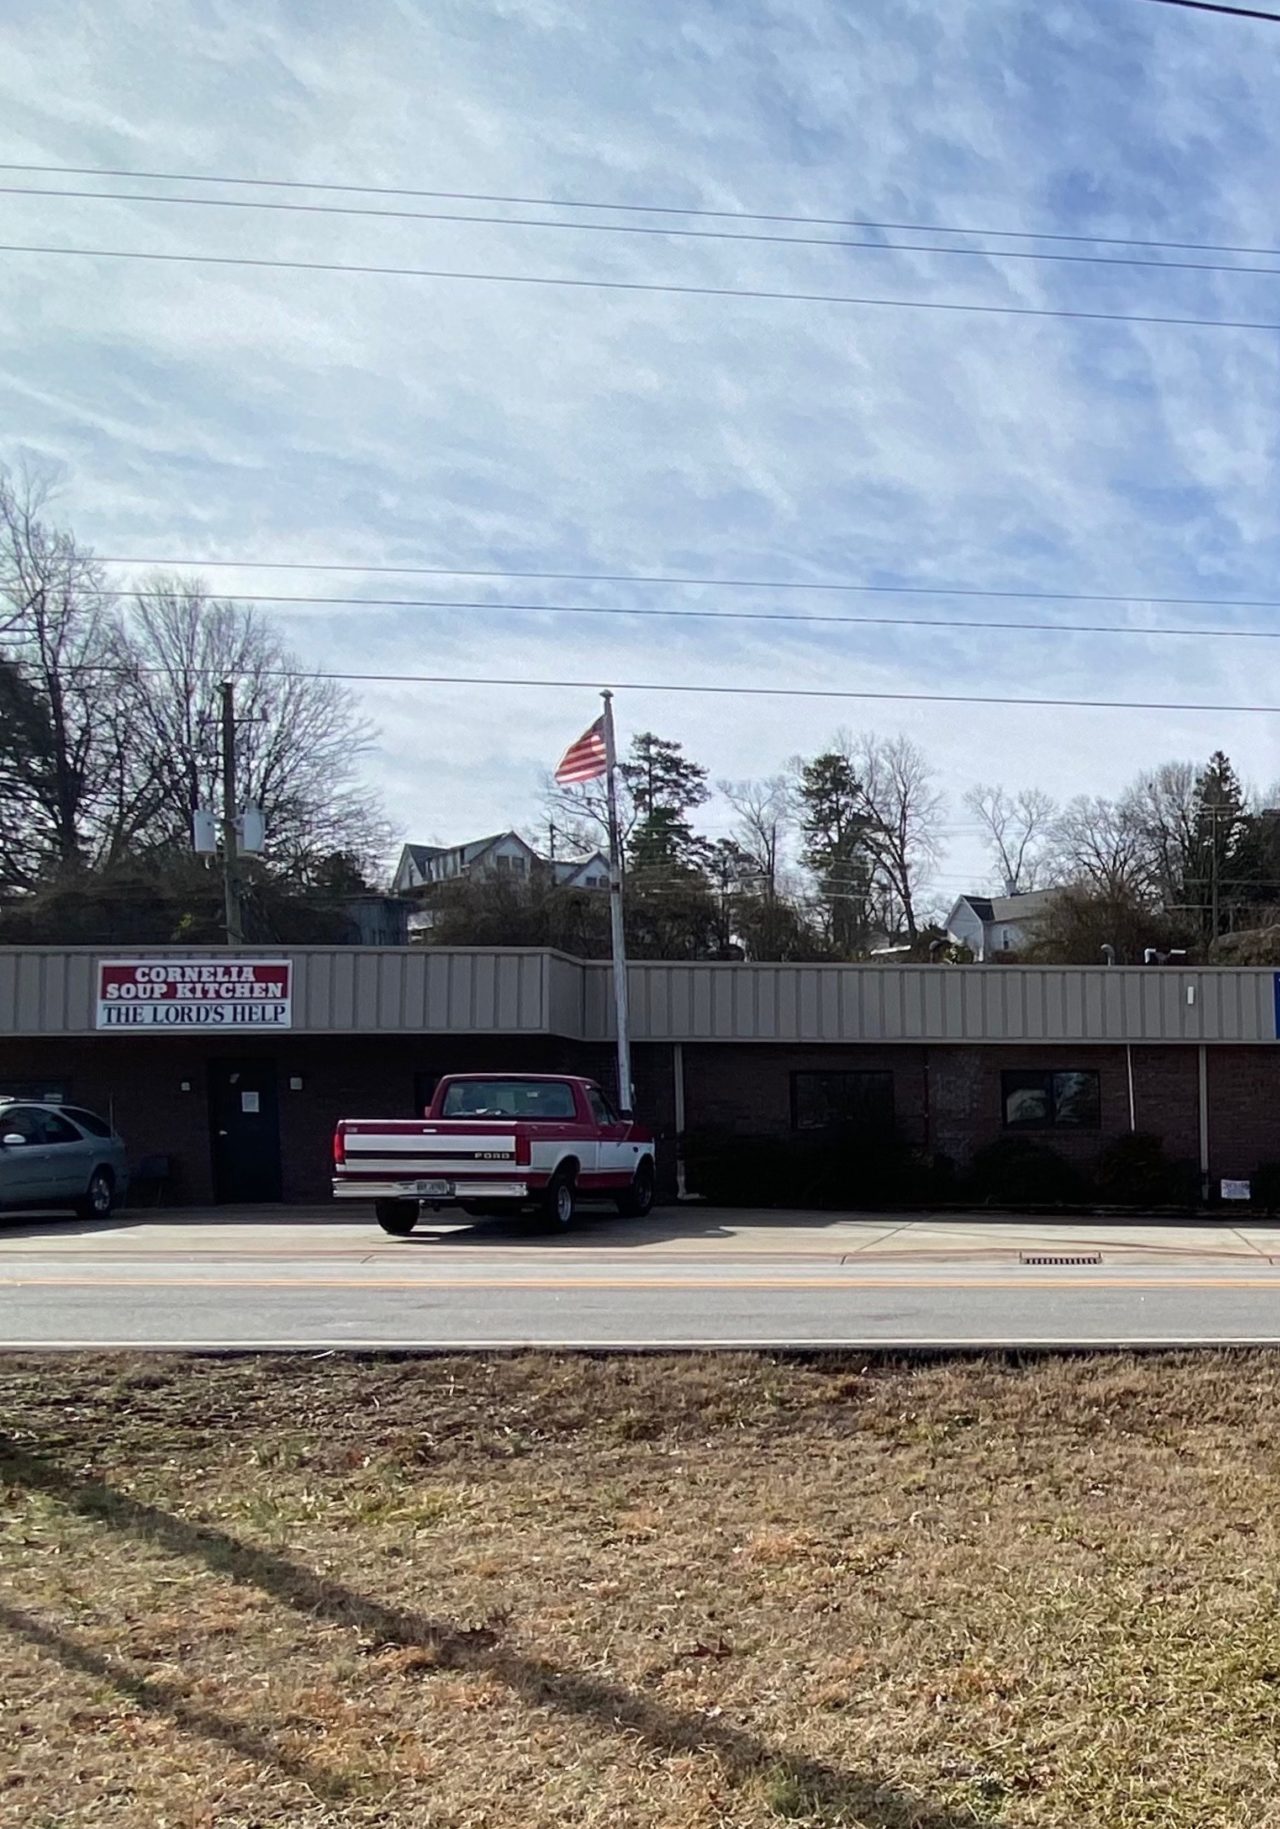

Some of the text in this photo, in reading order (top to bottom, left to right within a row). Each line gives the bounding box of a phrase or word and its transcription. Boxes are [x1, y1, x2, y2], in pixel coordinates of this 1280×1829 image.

[135, 967, 255, 982] CORNELIA
[106, 983, 282, 999] SOUP KITCHEN
[103, 1005, 285, 1023] THE LORD'S HELP
